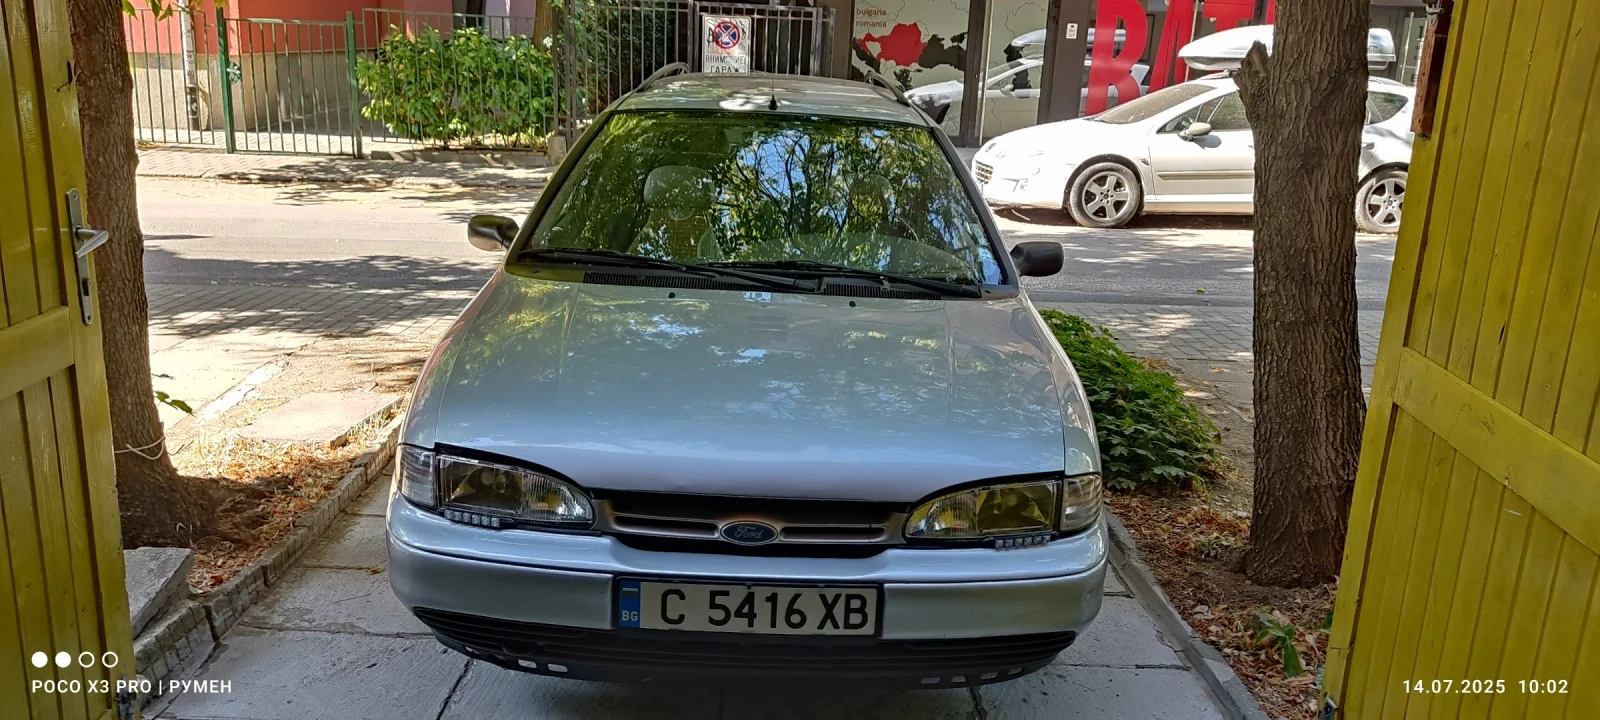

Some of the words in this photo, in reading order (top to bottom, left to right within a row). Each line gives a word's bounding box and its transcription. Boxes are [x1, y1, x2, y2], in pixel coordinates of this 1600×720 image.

[856, 7, 887, 16] bulgaria
[856, 20, 887, 28] romania
[1085, 0, 1275, 115] RAT
[734, 525, 764, 539] Ford
[622, 610, 639, 622] BG
[708, 590, 808, 630] 5416
